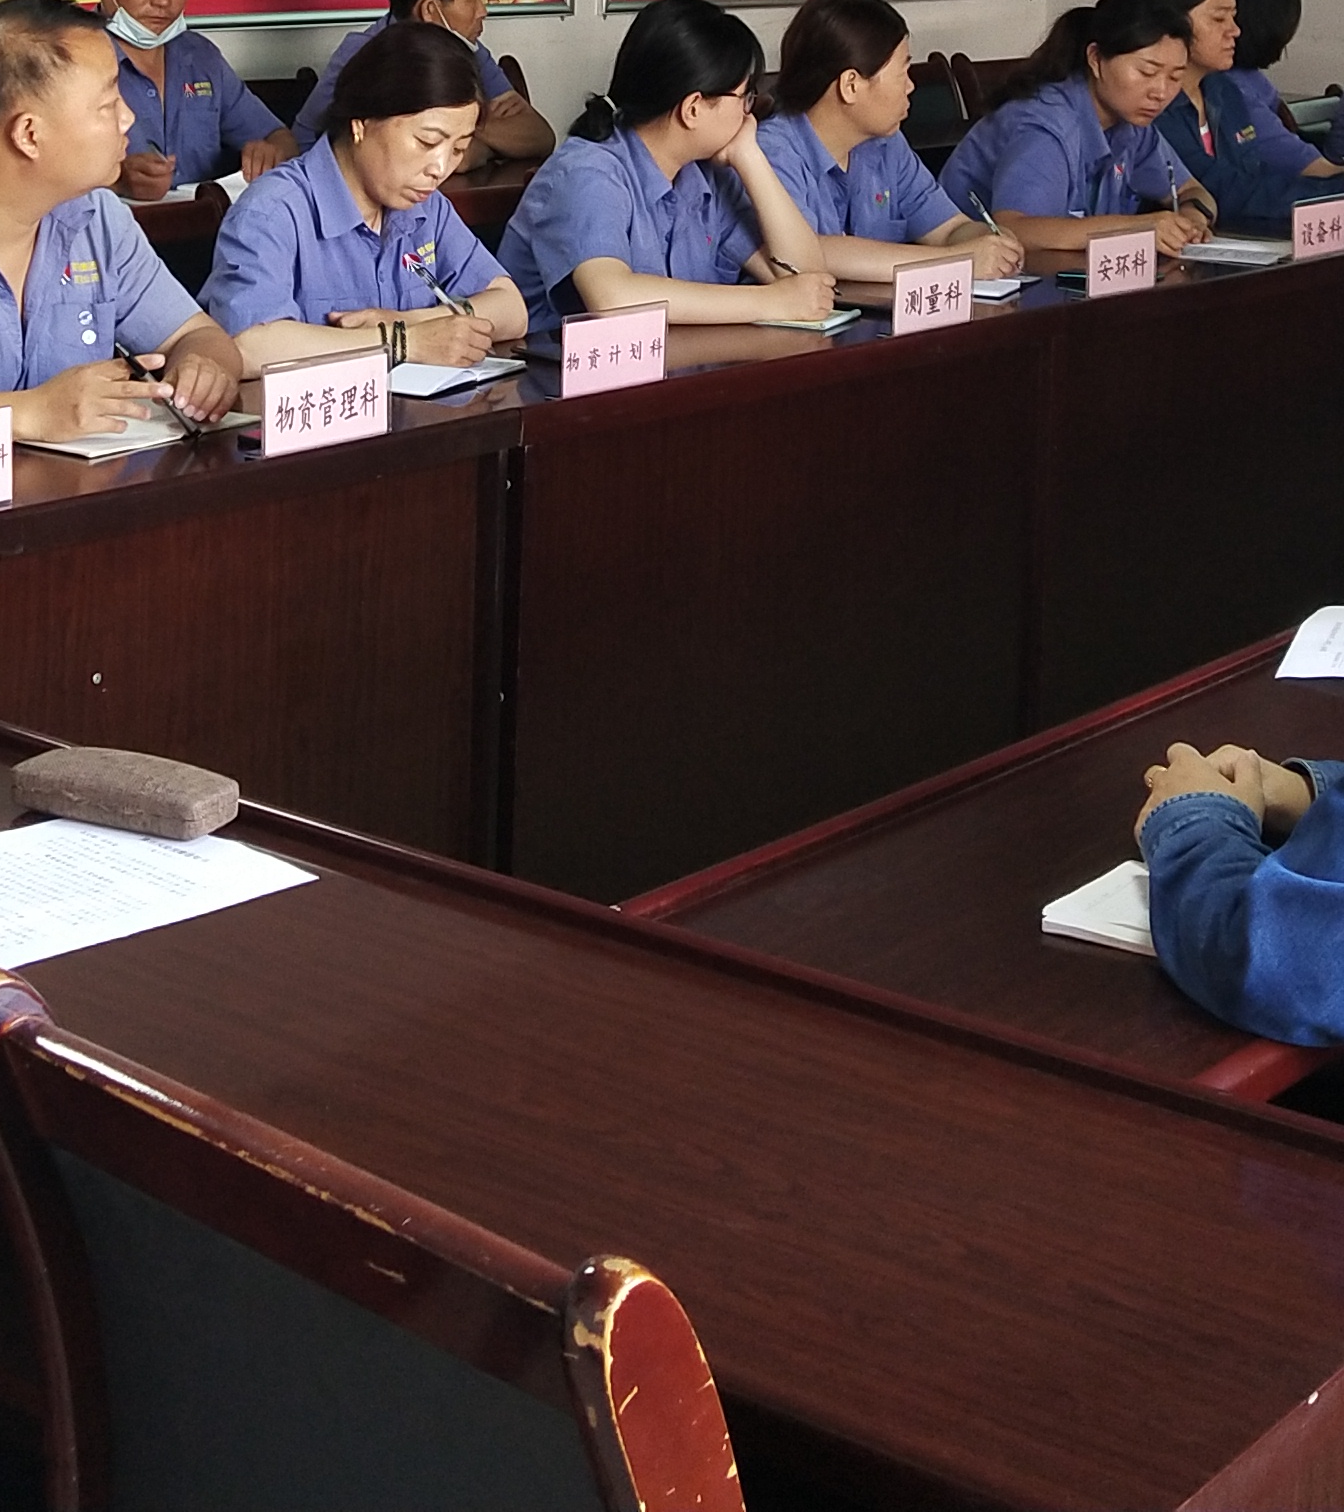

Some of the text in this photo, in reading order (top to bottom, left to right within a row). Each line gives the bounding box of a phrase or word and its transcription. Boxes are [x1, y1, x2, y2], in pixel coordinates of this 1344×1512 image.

[1301, 212, 1344, 247] 设备科
[1096, 249, 1150, 282] 安环科
[903, 279, 963, 318] 测量科
[565, 336, 664, 373] 物资计划科
[275, 377, 379, 433] 物资管理科
